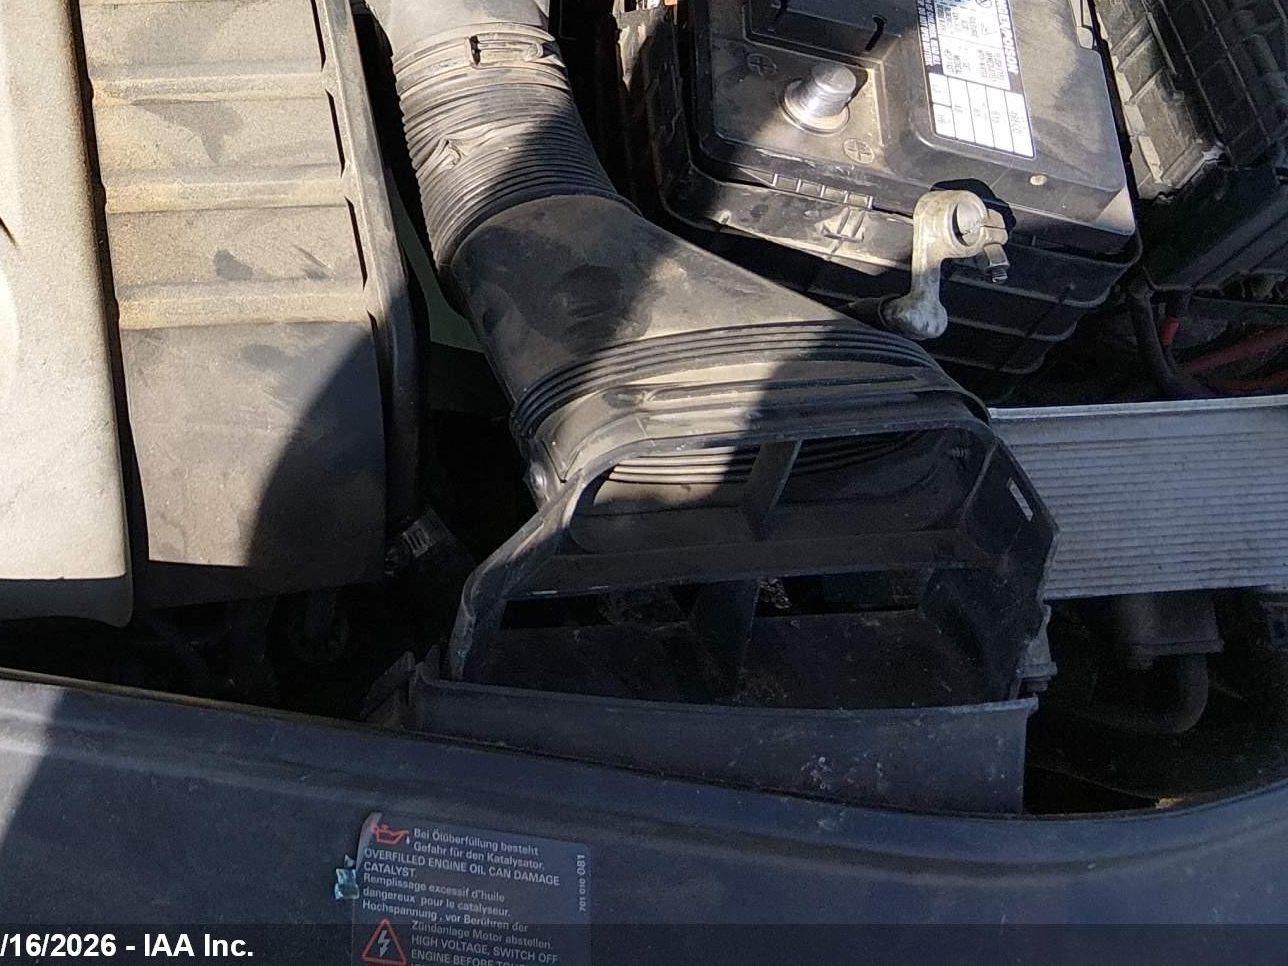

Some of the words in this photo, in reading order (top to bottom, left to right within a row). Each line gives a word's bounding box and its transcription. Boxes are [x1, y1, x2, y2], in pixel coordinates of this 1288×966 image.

[413, 842, 447, 855] Gefahr
[449, 846, 463, 858] für
[466, 849, 485, 861] den
[414, 828, 430, 840] Bei
[432, 828, 498, 852] Ölüberfüllung
[500, 841, 539, 856] besteht
[364, 848, 426, 866] OVERFILLED
[428, 857, 467, 873] ENGINE
[469, 863, 486, 875] OIL
[488, 866, 511, 879] CAN
[513, 870, 560, 886] DAMAGE
[576, 854, 586, 876] 081
[363, 872, 426, 893] Remplissage
[428, 884, 470, 898] excessif
[578, 878, 586, 895] 010
[363, 886, 416, 904] dangereux
[420, 897, 444, 907] pour
[446, 898, 455, 908] le
[457, 902, 511, 917] catalyseur.
[362, 899, 438, 922] Hochspannung
[445, 915, 461, 923] vor
[463, 913, 510, 931] Berühren
[511, 921, 528, 933] der
[411, 920, 470, 939] Zündanlage
[472, 929, 503, 942] Motor
[411, 934, 438, 948] HIGH
[492, 946, 536, 961] SWITCH
[538, 953, 559, 964] OFF
[411, 949, 451, 964] ENGINE
[453, 955, 494, 966] BEFORE
